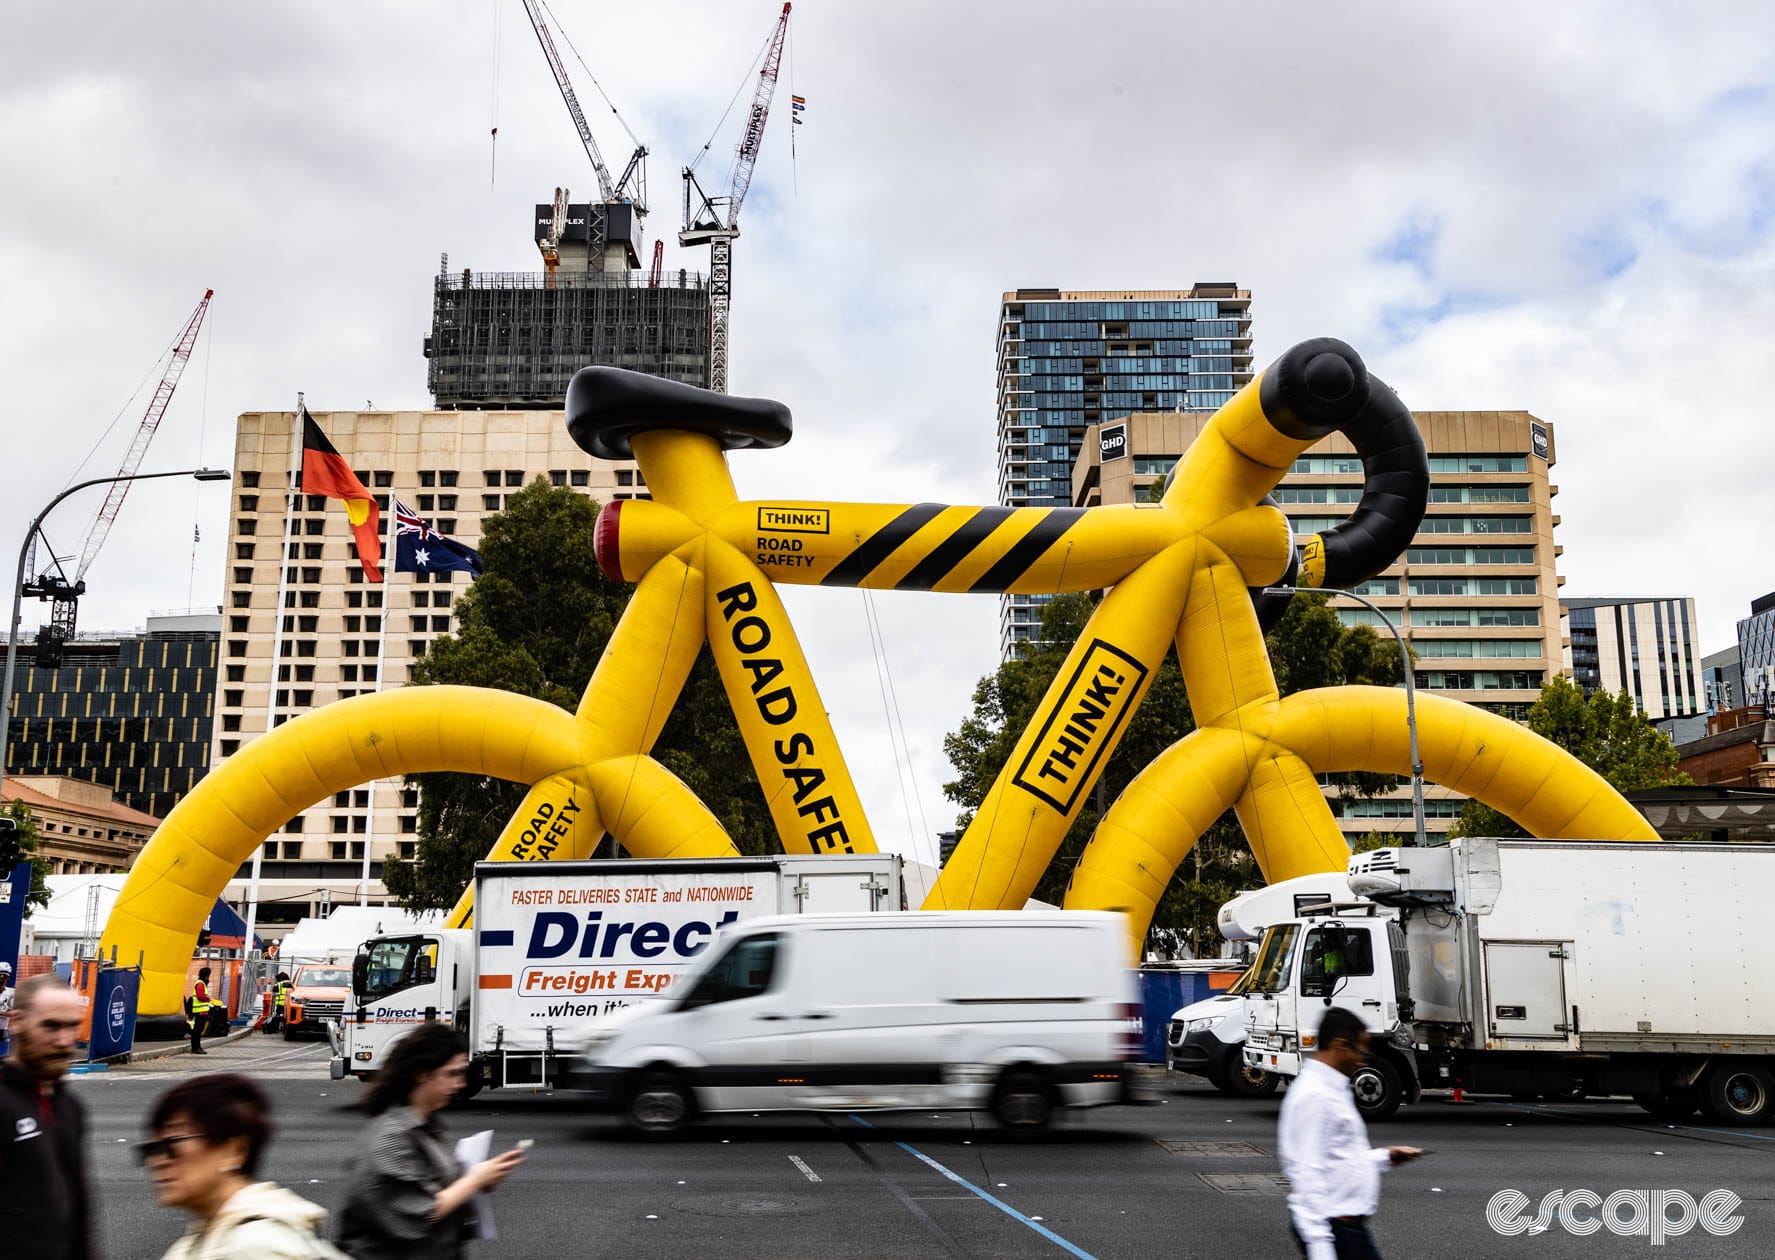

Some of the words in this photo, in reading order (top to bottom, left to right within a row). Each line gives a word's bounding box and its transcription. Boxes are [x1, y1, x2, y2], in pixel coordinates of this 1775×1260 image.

[744, 104, 763, 154] MULTIPLEX
[1102, 436, 1124, 450] GHD
[766, 512, 821, 526] THINK!
[757, 537, 803, 552] ROAD
[757, 553, 815, 567] SAFETY
[716, 581, 798, 726] ROAD
[774, 732, 855, 854] SAFE
[1038, 664, 1126, 784] THINK!
[511, 803, 554, 860] ROAD
[512, 890, 553, 905] FASTER
[557, 890, 620, 904] DELIVERIES
[625, 888, 657, 903] STATE
[663, 888, 682, 902] and
[687, 886, 753, 902] NATIONWIDE
[525, 971, 616, 993] Freight
[377, 1008, 417, 1018] Direct
[530, 1002, 598, 1017] ...when
